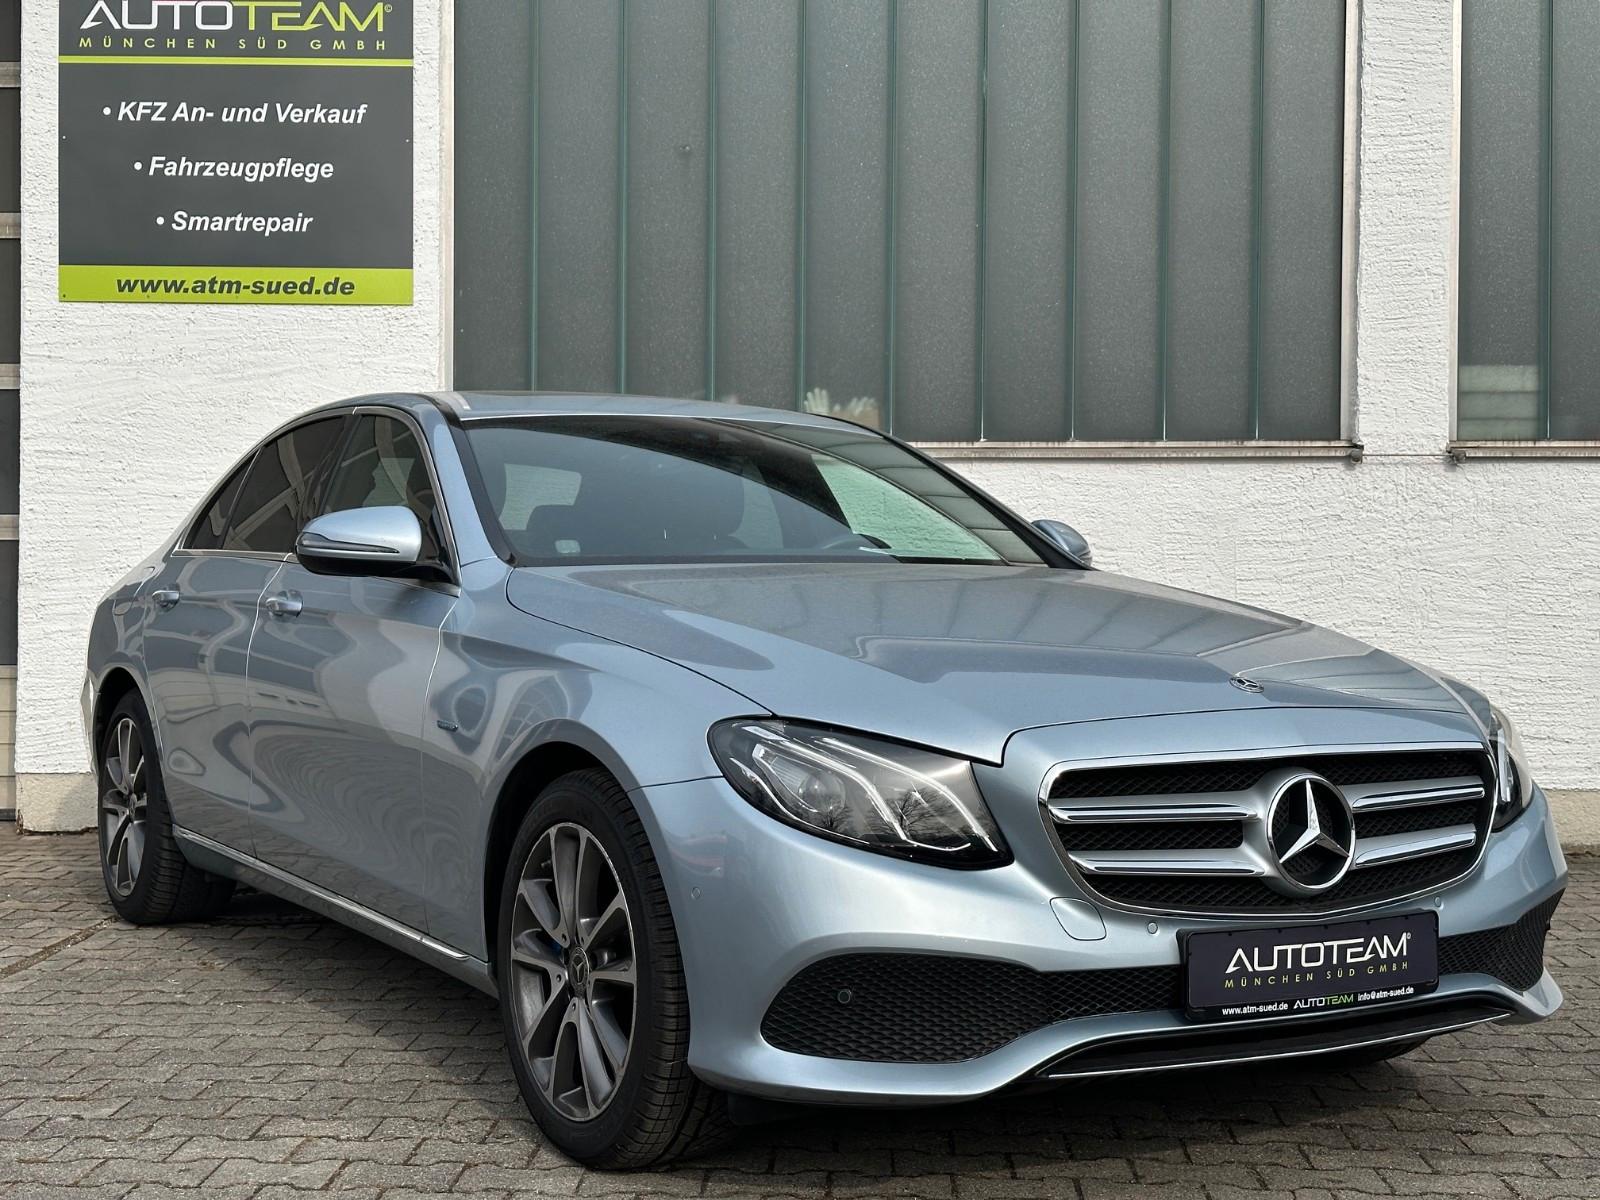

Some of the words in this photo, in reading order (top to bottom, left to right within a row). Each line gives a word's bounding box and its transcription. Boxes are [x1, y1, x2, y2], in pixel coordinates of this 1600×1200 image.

[79, 36, 216, 49] MÜNCHEN
[238, 37, 287, 50] SÜD
[310, 39, 386, 51] GMBH
[117, 101, 167, 122] KFZ
[171, 103, 215, 123] An-
[221, 103, 268, 123] und
[275, 103, 368, 124] Verkauf
[148, 156, 335, 183] Fahrzeugpflege
[171, 210, 314, 237] Smartrepair
[116, 275, 356, 296] www.atm-sued.de
[1224, 972, 1314, 989] MÜNCHEN
[1326, 967, 1356, 980] SÜD
[1367, 961, 1409, 975] GMBH
[1222, 1001, 1289, 1016] www.atm-sued.de
[1293, 993, 1354, 1010] AUTOTEAM
[1357, 985, 1415, 1002] info@atm-sued.de
